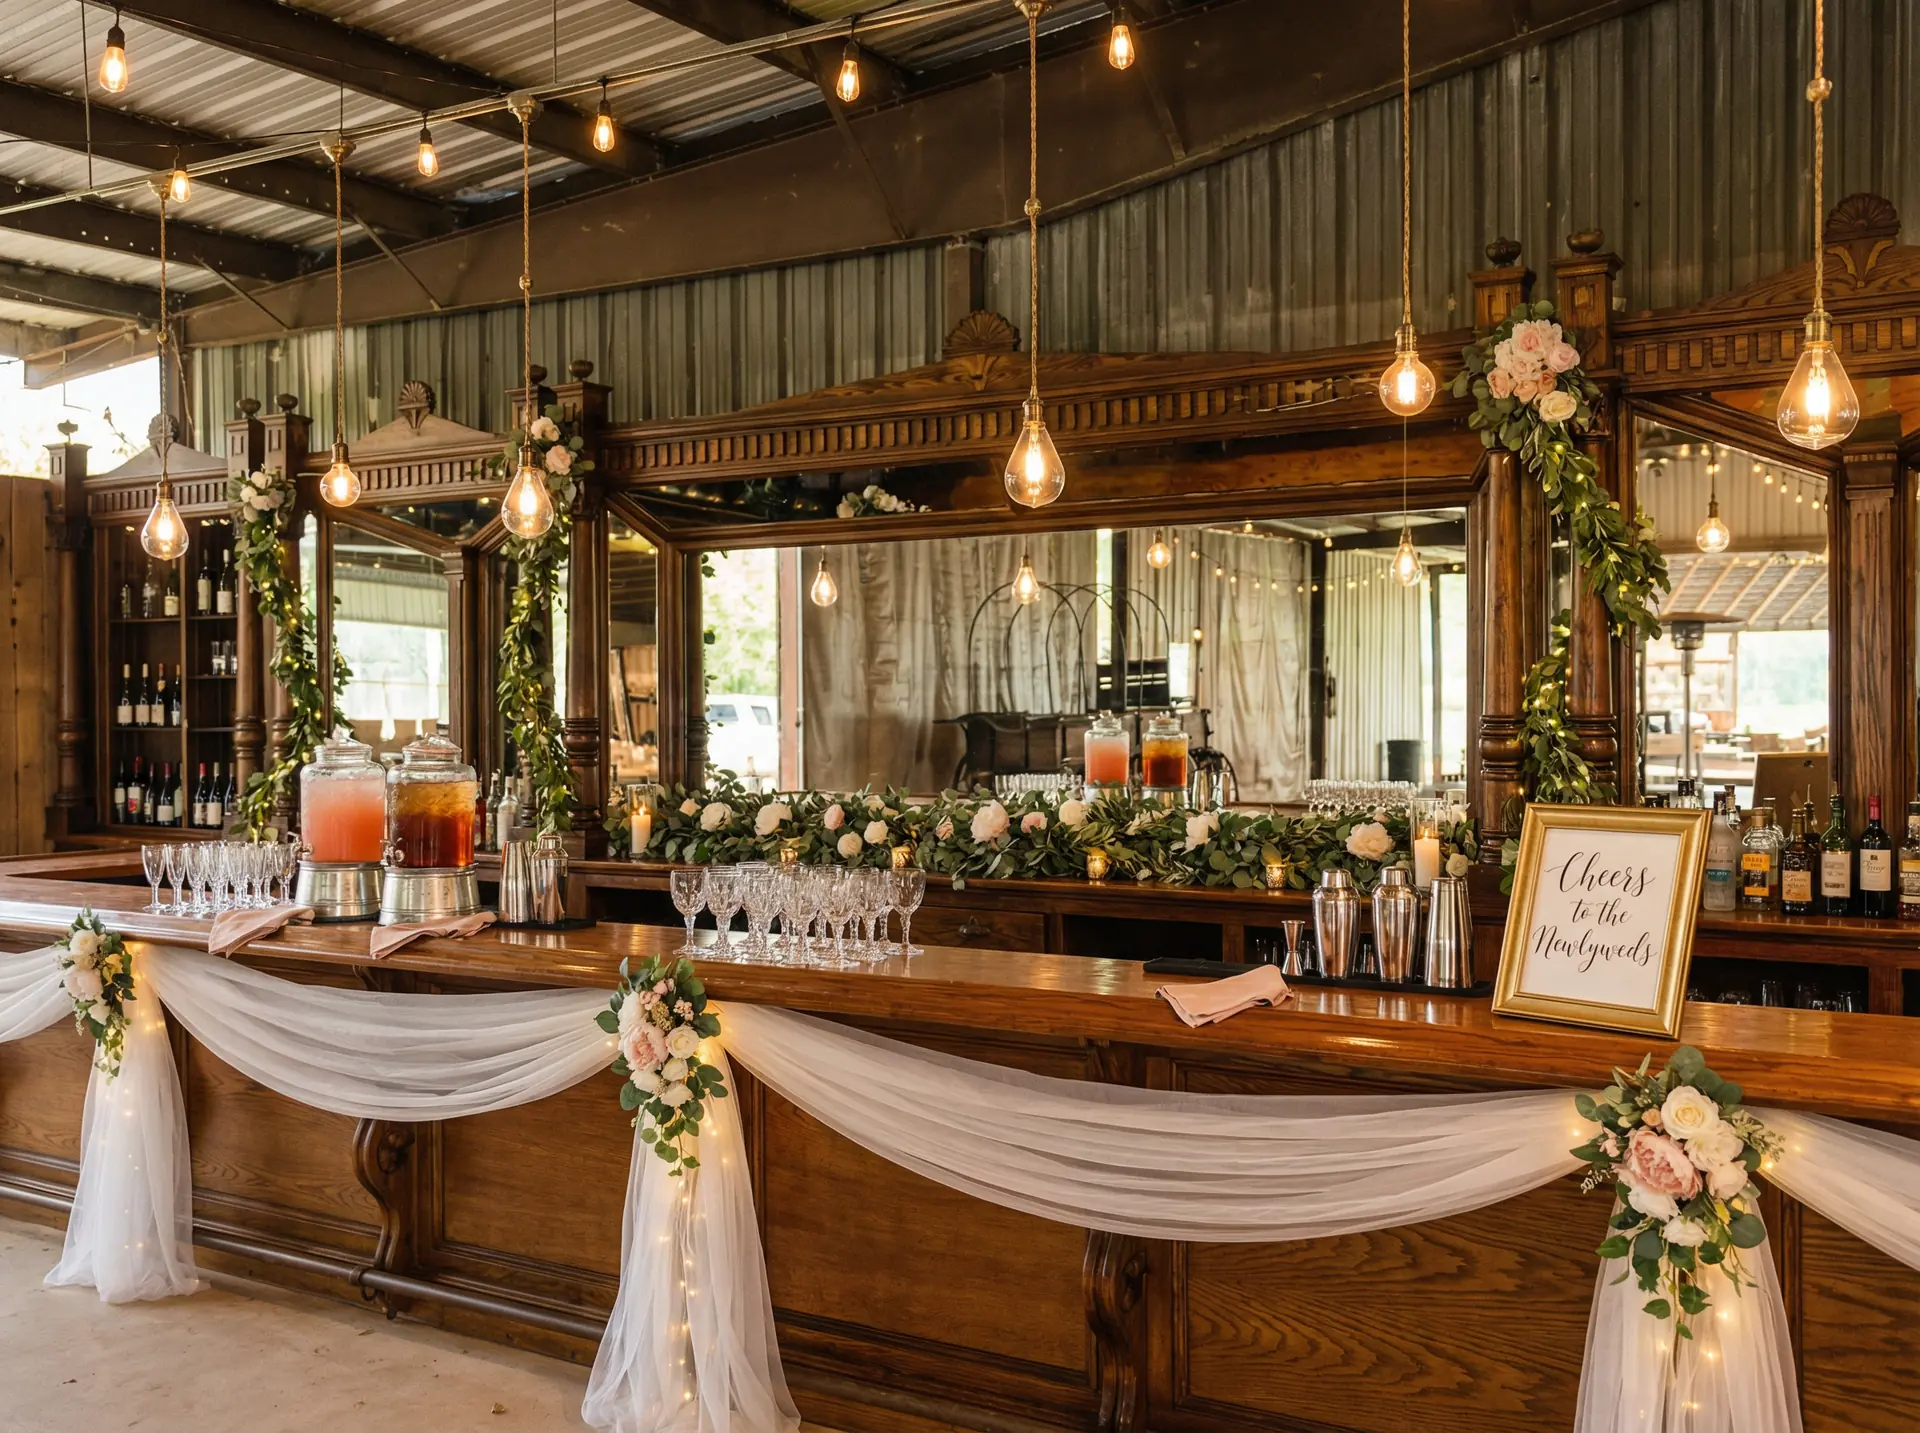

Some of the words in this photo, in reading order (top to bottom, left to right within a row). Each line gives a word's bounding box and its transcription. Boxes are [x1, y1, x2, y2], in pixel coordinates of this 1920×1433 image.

[1544, 852, 1656, 897] Cheers
[1570, 898, 1593, 924] to
[1596, 897, 1632, 926] the
[1532, 924, 1659, 973] Newlyweds
